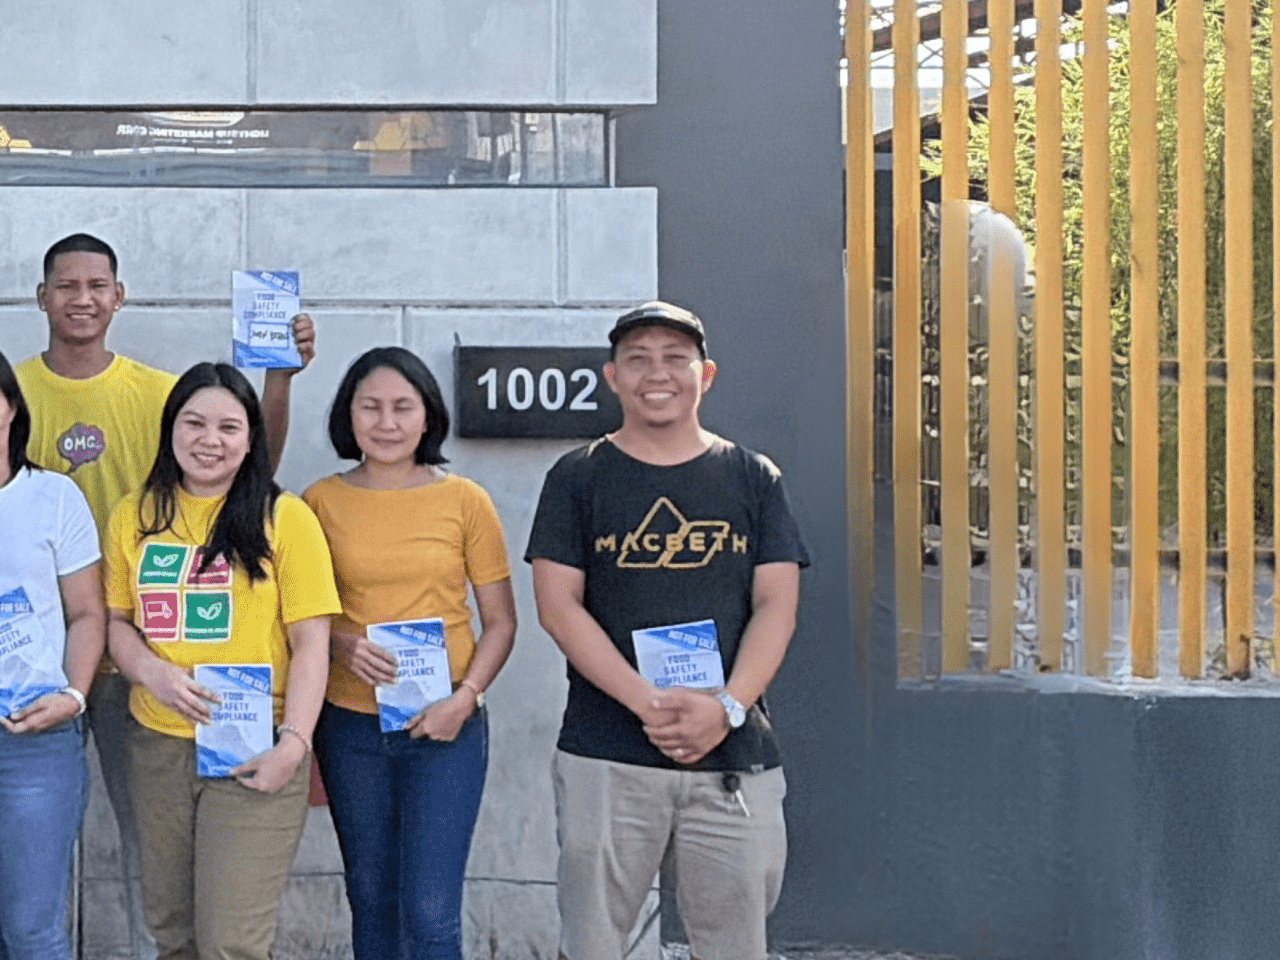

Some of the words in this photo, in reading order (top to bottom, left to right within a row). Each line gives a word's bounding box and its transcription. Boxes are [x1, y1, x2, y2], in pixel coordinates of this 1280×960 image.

[477, 366, 599, 411] 1002
[595, 532, 748, 554] MACBETH
[664, 663, 697, 675] SAFETY
